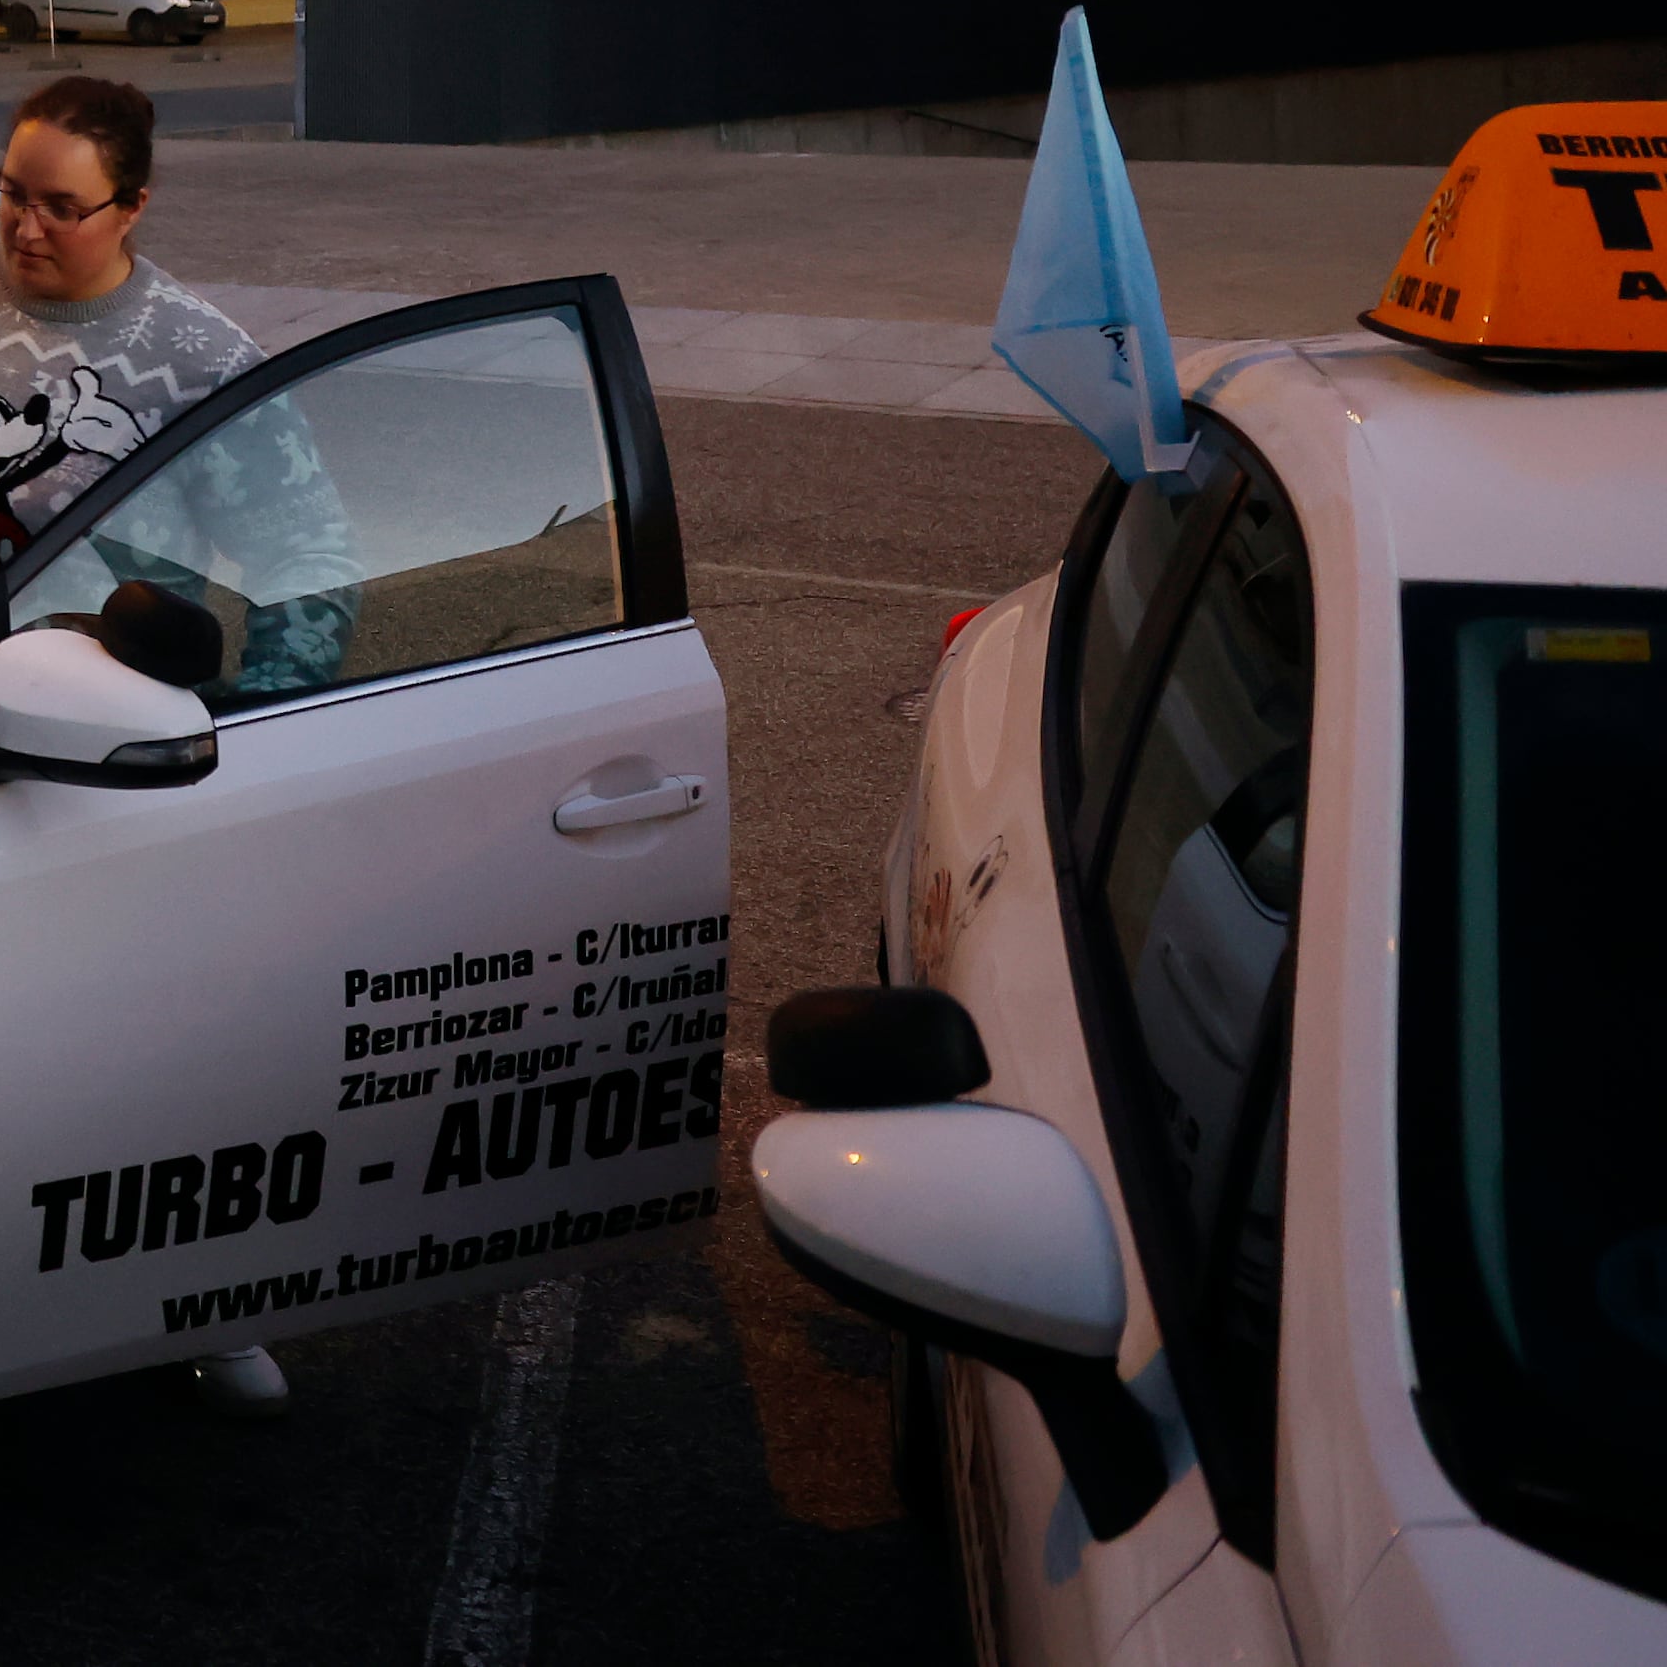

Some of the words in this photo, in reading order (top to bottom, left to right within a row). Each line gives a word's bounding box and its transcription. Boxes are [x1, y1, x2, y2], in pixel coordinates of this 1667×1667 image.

[344, 949, 534, 1007] Pamplona
[343, 997, 529, 1062] Berriozar
[337, 1066, 440, 1112] Zizur
[452, 1038, 582, 1091] Mayor
[31, 1129, 327, 1274] TURBO
